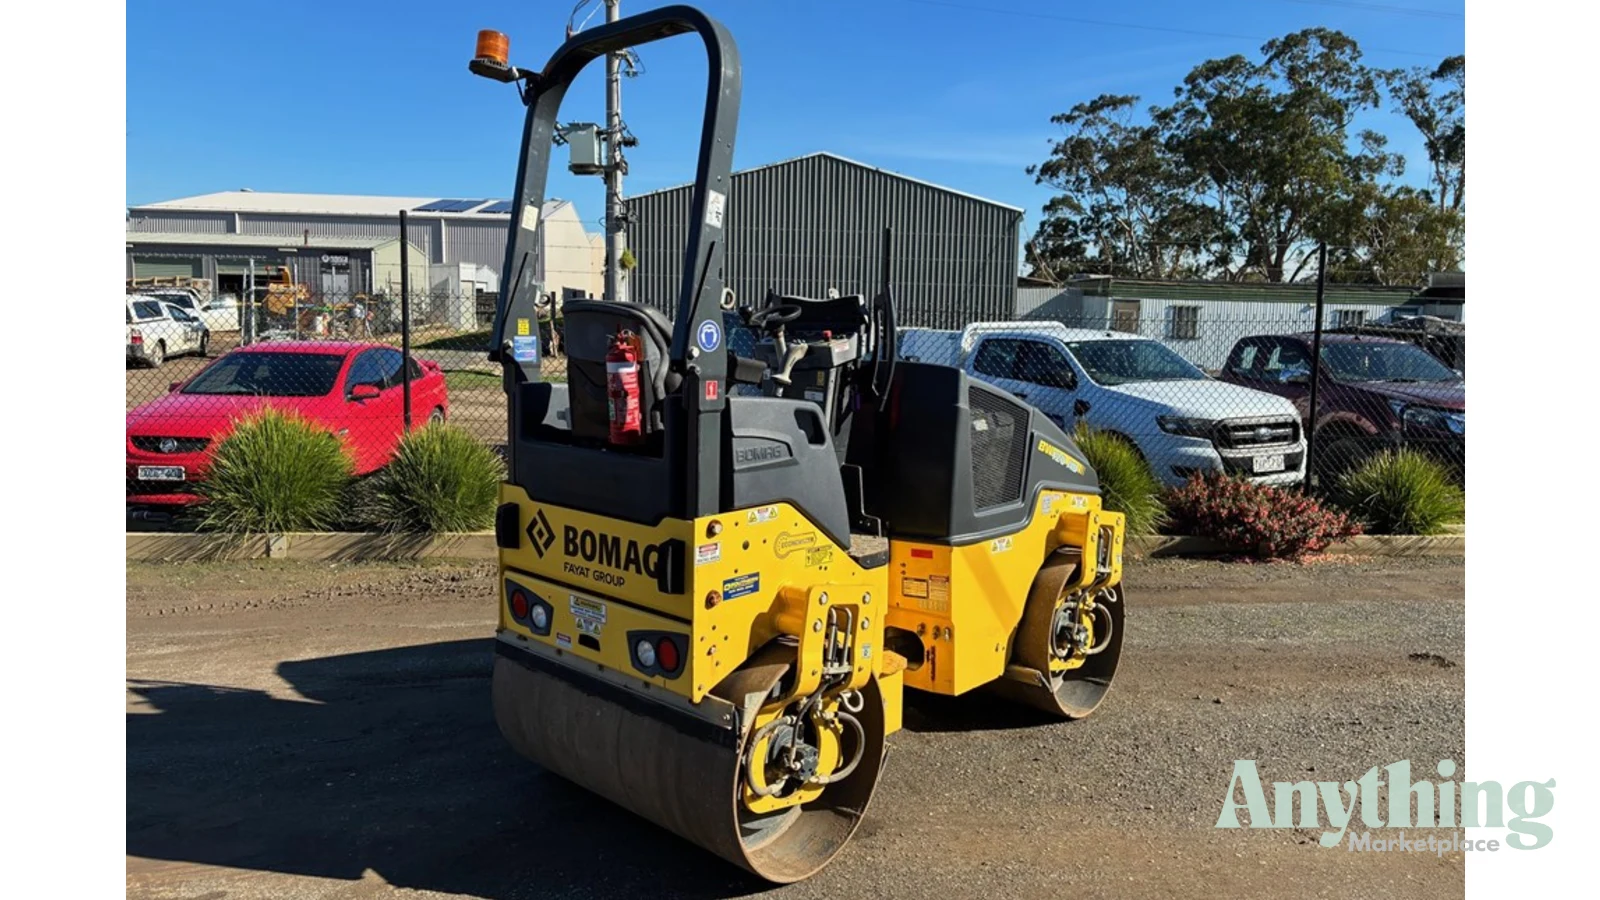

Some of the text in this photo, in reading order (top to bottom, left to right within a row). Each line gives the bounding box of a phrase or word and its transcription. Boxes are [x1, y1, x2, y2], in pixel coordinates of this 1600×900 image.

[736, 445, 782, 463] BOMAG
[563, 524, 659, 579] BOMAG
[563, 562, 625, 587] FAYAT GROUP
